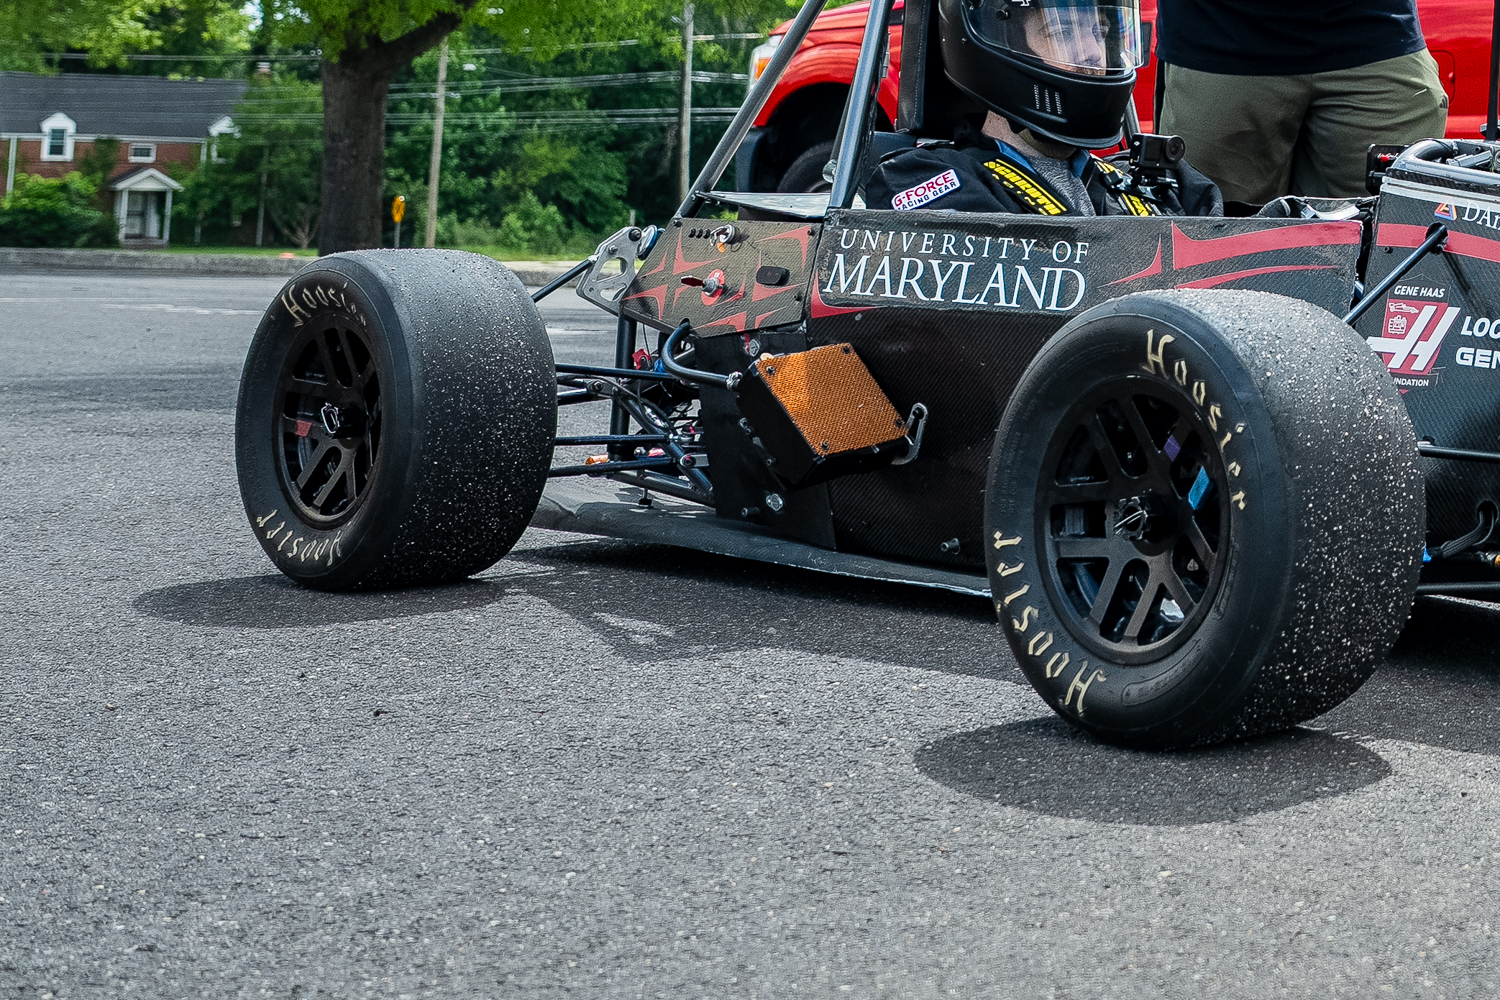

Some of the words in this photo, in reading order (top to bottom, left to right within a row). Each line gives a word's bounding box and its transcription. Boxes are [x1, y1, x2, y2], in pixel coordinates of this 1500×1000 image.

[894, 171, 954, 207] G-FORCE
[932, 182, 957, 197] GEAR
[840, 229, 1037, 261] UNIVERSITY
[1052, 240, 1089, 264] OF
[822, 253, 1087, 312] MARYLAND
[1394, 285, 1419, 296] GENE
[1420, 287, 1446, 298] HAAS
[1393, 377, 1429, 387] NDATION
[1143, 328, 1245, 510] Hoosier
[993, 531, 1105, 717] Hoosier
